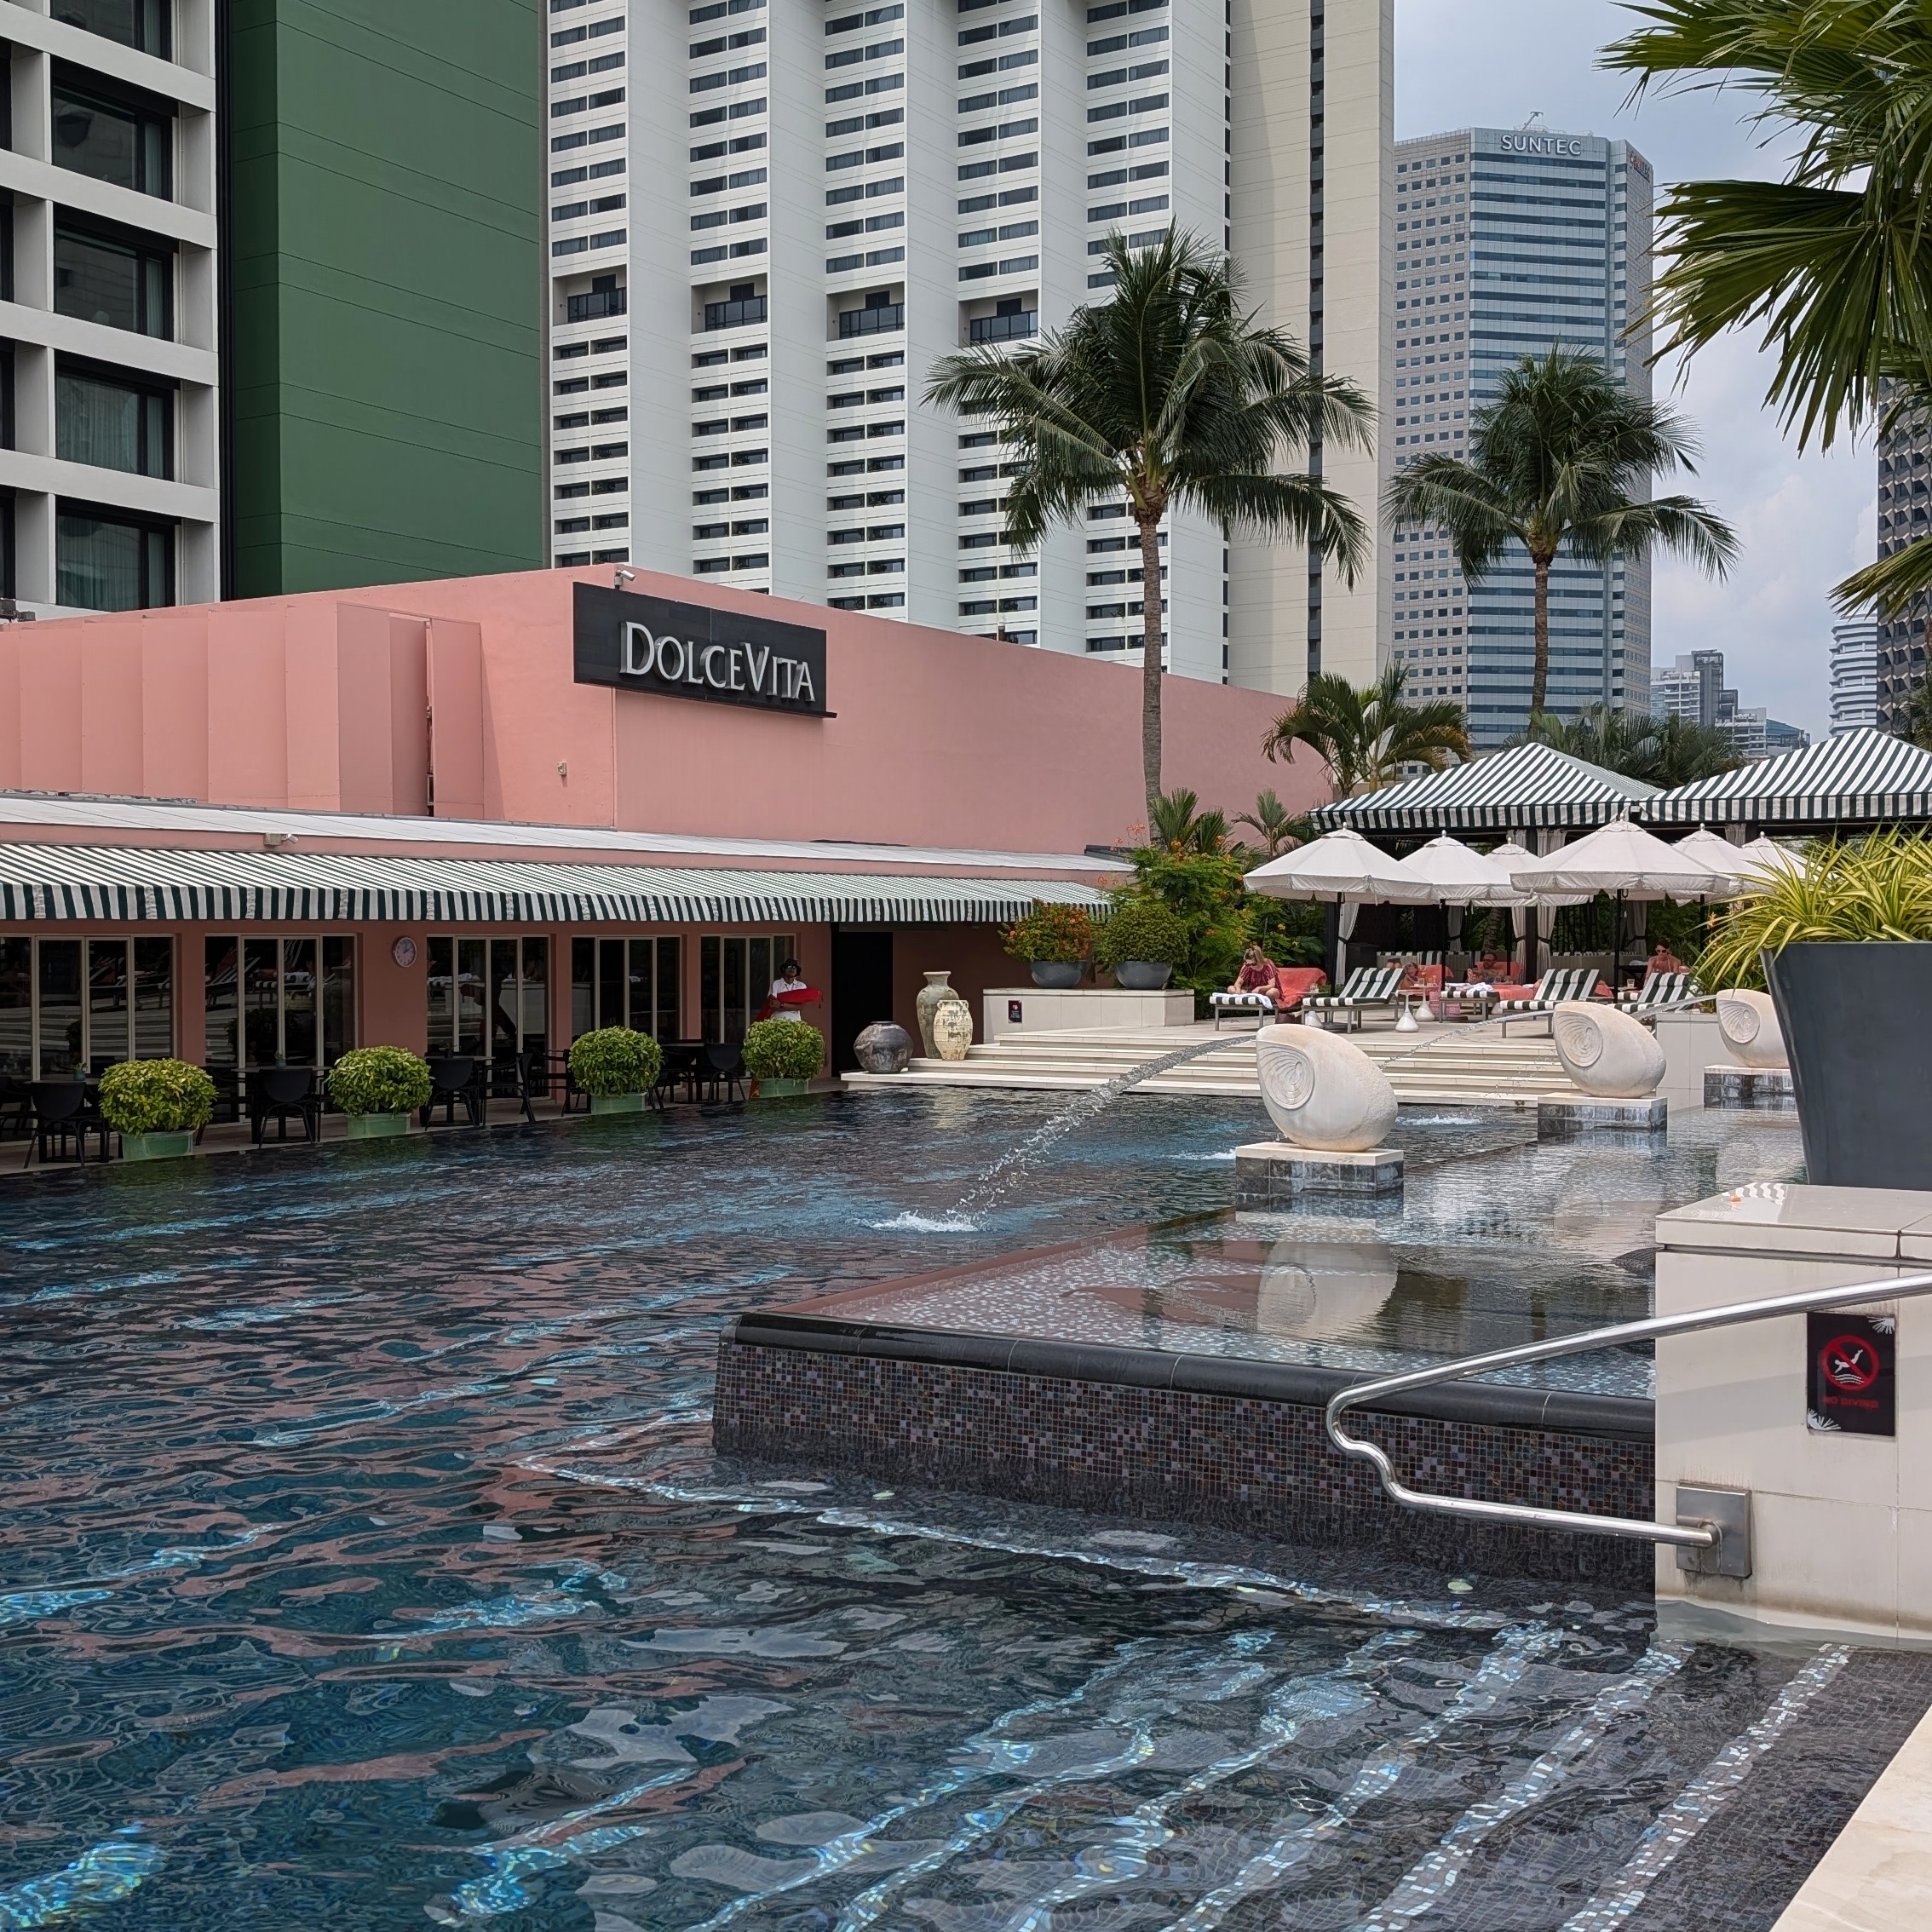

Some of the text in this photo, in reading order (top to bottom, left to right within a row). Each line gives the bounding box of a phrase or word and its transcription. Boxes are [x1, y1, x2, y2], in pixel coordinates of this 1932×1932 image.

[1501, 134, 1581, 155] SUNTEC
[1823, 1396, 1878, 1409] NO DIVING
